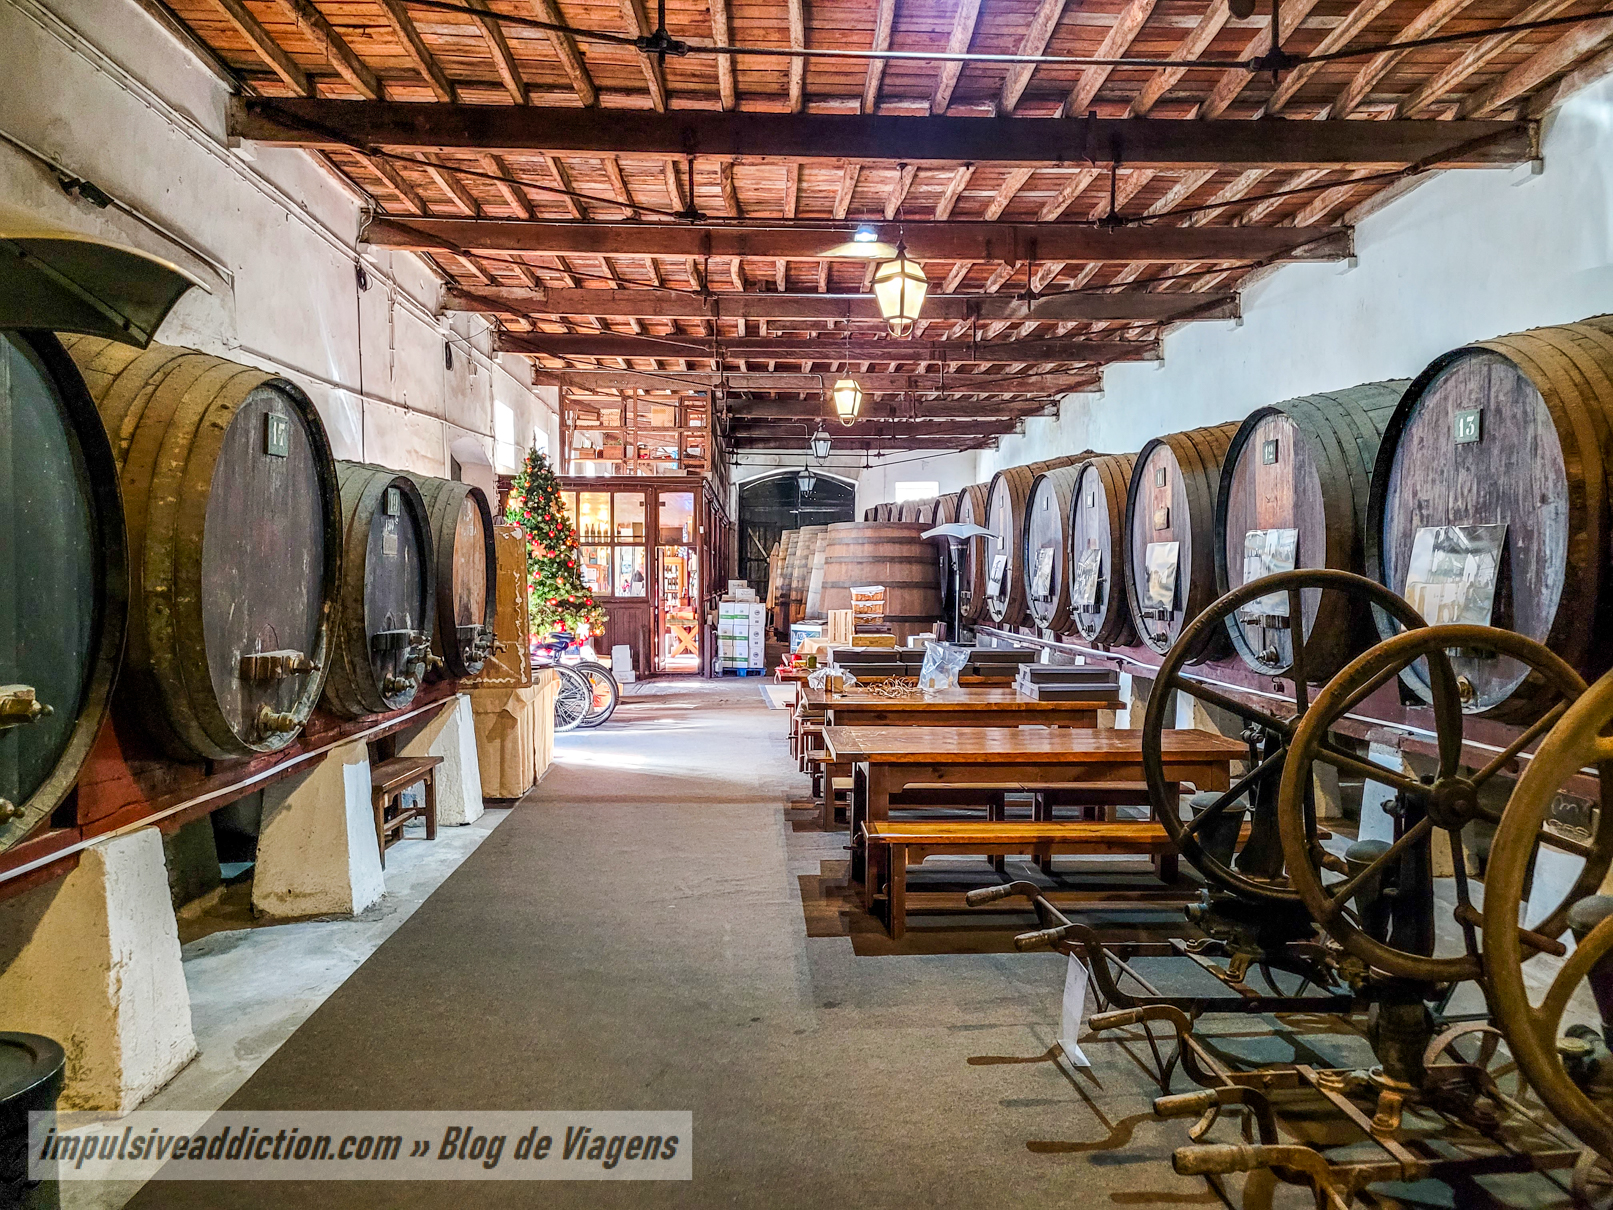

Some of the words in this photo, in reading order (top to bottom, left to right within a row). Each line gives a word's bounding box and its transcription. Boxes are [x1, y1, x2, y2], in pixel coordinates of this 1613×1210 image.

[273, 421, 286, 446] 17
[1459, 415, 1475, 438] 13
[390, 493, 398, 512] 19
